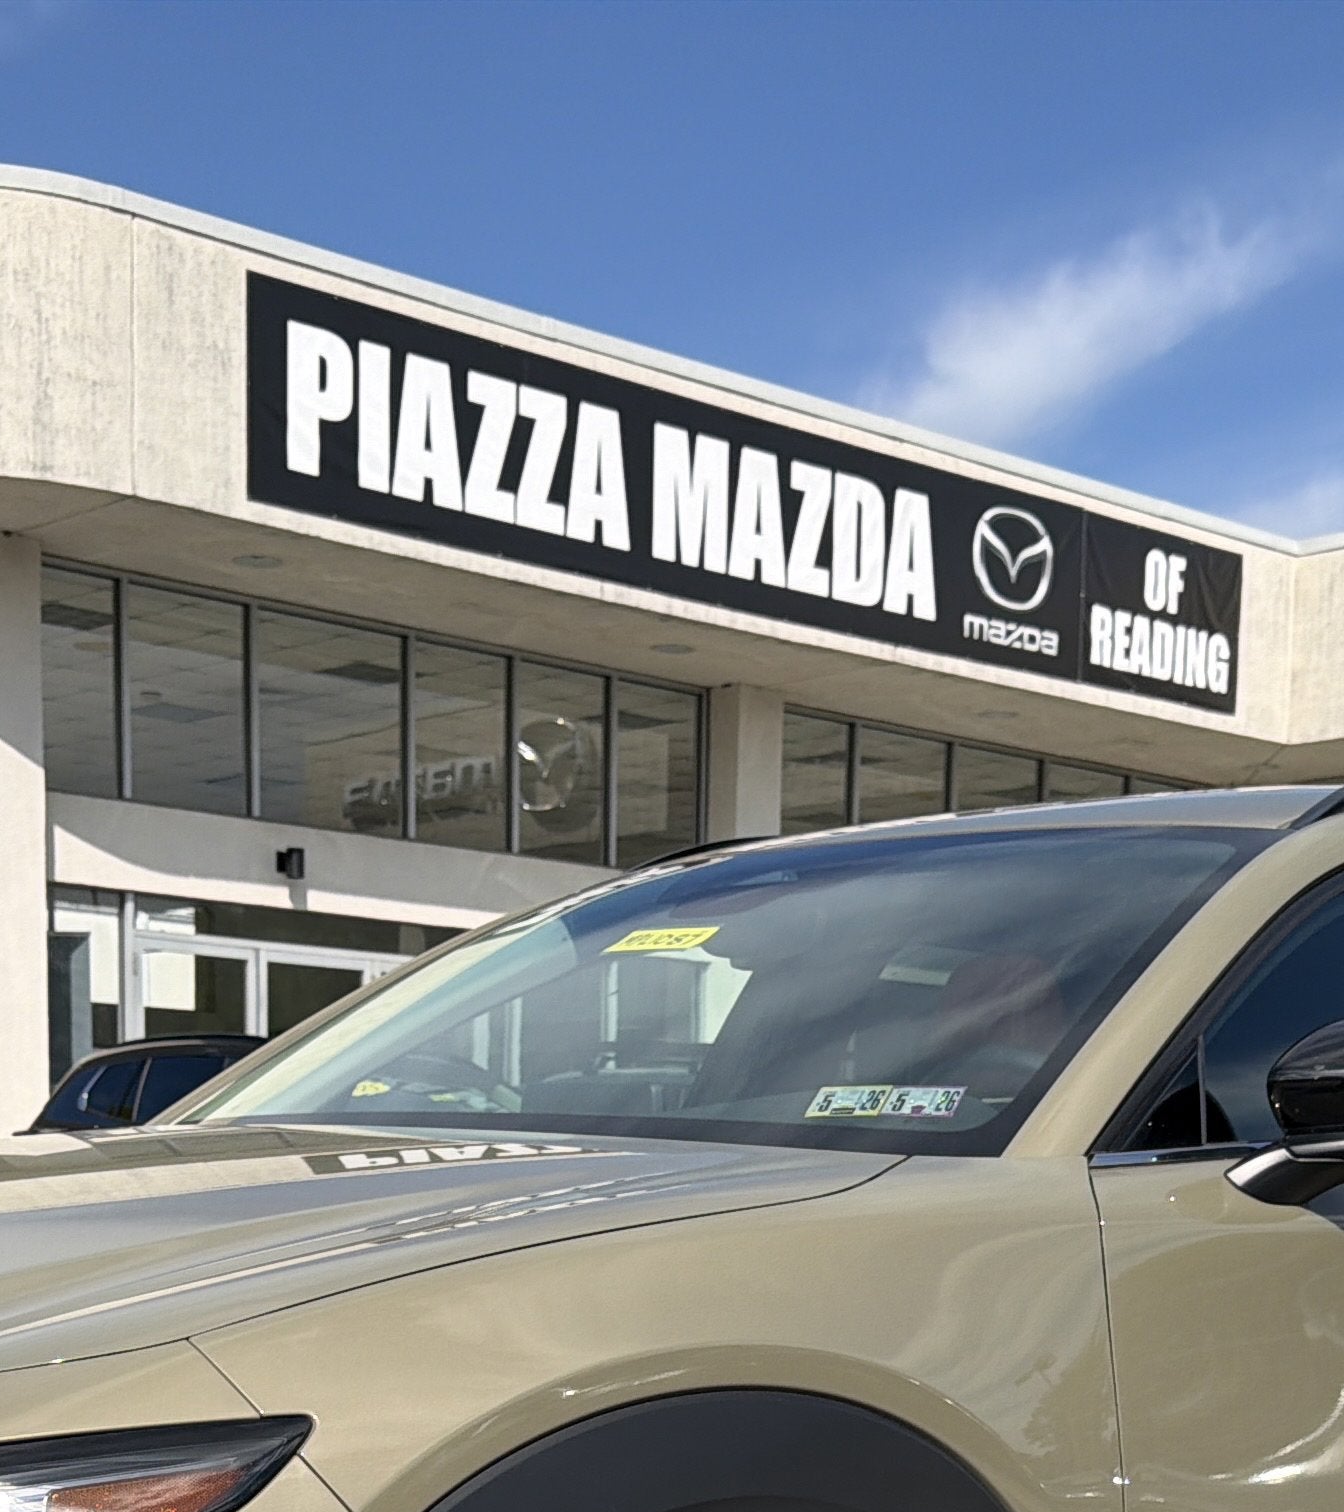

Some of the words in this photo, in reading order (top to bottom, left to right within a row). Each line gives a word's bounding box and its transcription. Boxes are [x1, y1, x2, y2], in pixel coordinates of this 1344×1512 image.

[285, 318, 631, 552] PIAZZA
[651, 420, 937, 623] MAZDA
[1143, 548, 1187, 615] OF
[962, 612, 1060, 657] mazda
[1089, 603, 1231, 695] READING
[818, 1091, 836, 1112] 5
[859, 1089, 887, 1112] 26
[891, 1091, 910, 1112] 5
[933, 1090, 961, 1112] 26
